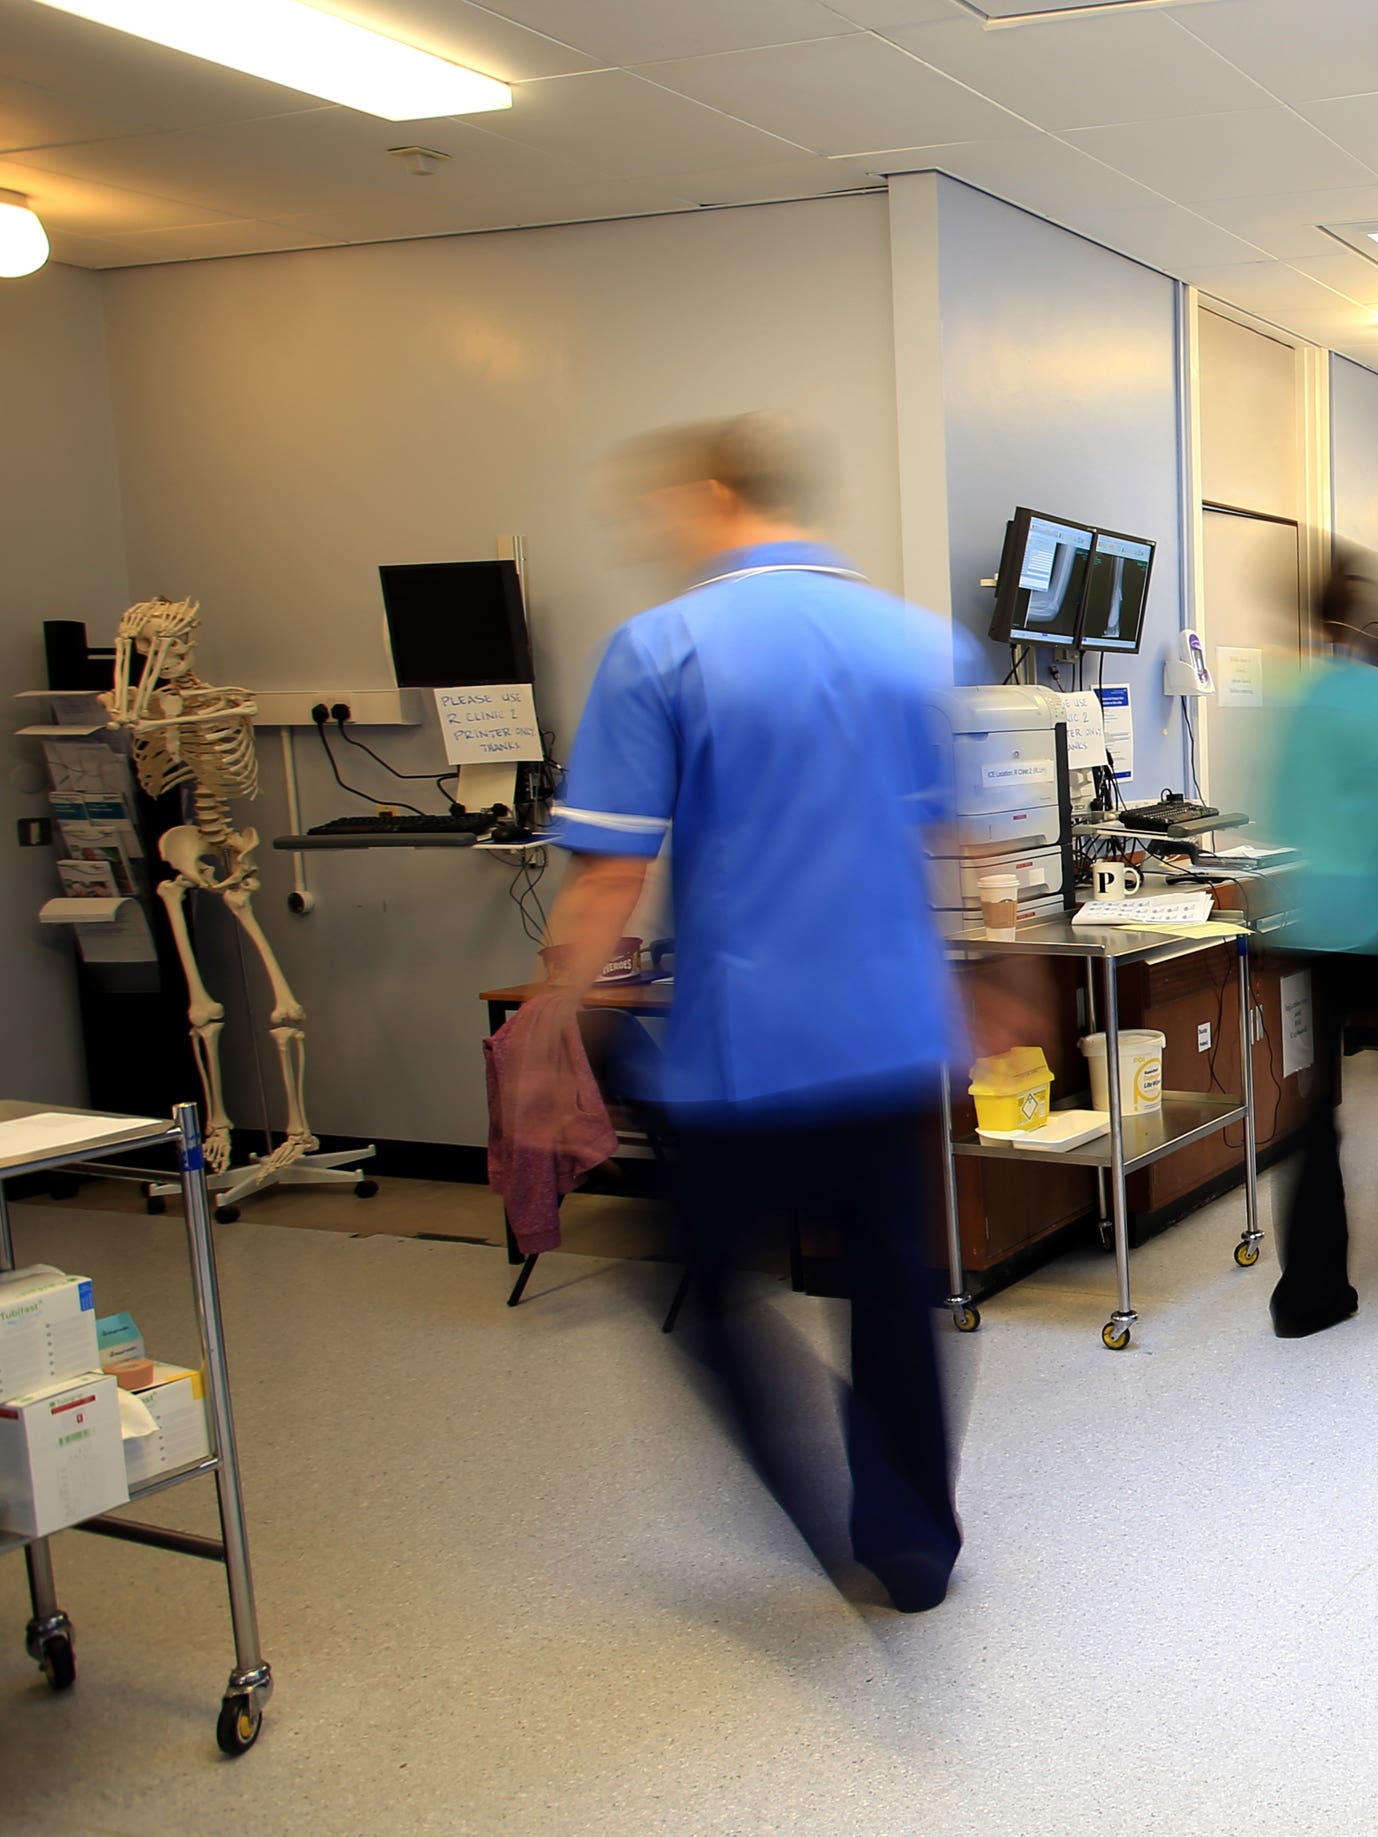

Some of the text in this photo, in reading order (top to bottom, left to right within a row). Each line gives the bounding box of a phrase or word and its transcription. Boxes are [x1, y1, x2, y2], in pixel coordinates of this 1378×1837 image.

[441, 693, 523, 707] PLEASE USE
[466, 711, 504, 722] CLINIC
[1082, 711, 1090, 723] 2
[454, 728, 512, 741] PRINTER
[480, 742, 520, 753] THANKS
[1097, 872, 1115, 894] P
